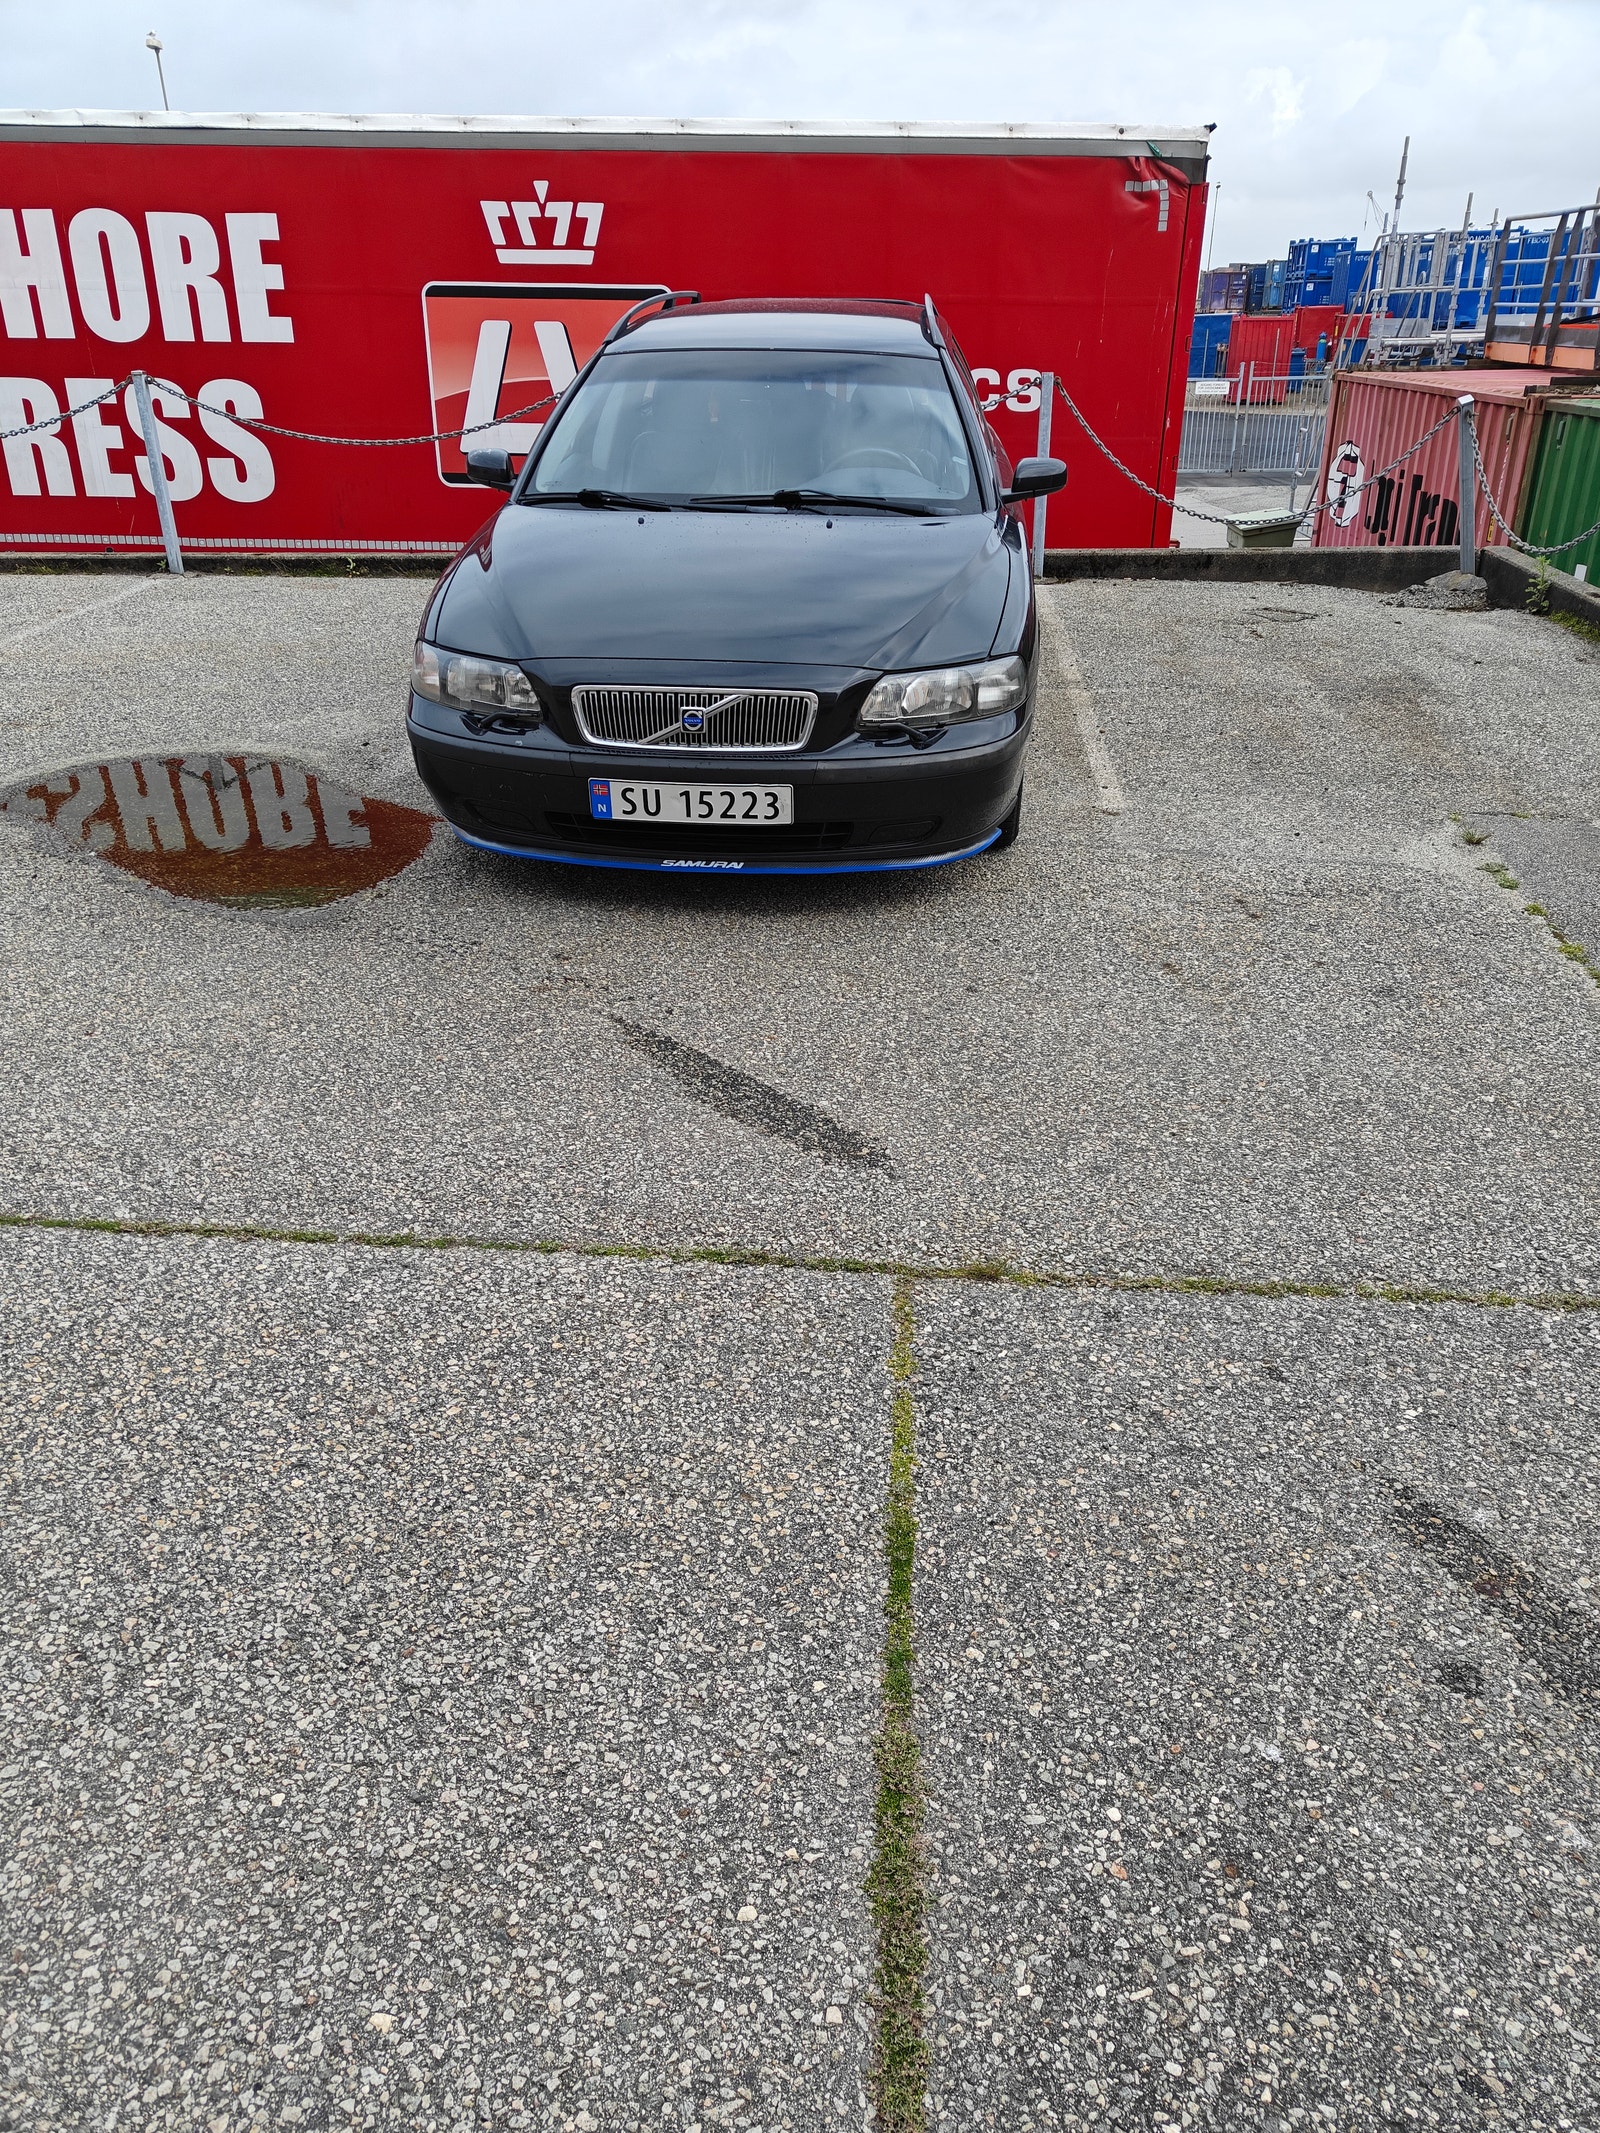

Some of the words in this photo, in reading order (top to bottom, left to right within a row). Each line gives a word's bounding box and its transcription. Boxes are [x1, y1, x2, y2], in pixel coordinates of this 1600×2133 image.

[597, 803, 607, 813] N
[620, 787, 662, 817] SU
[679, 790, 780, 820] 15223
[660, 859, 745, 869] SAMURAI
